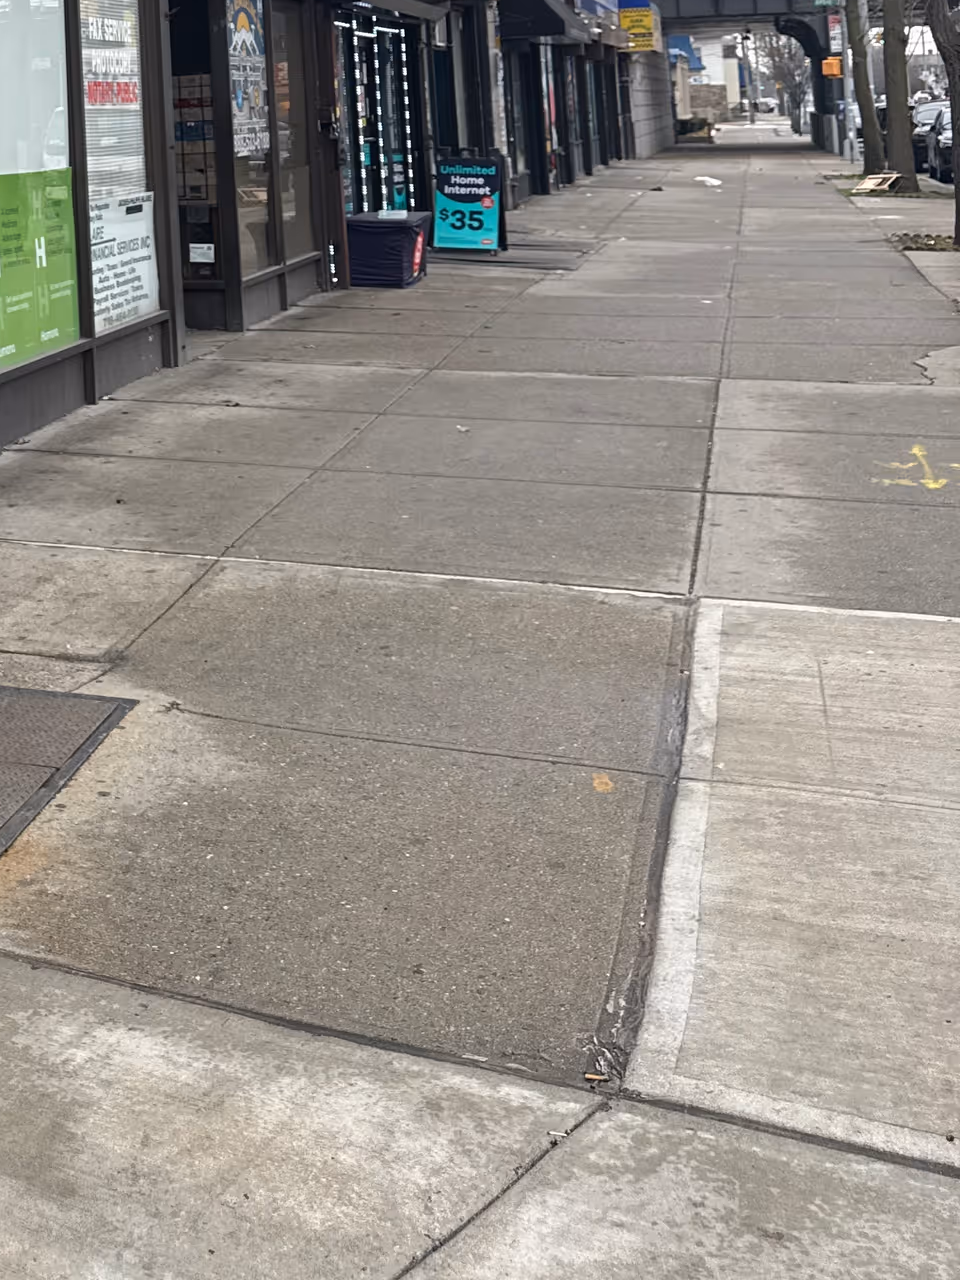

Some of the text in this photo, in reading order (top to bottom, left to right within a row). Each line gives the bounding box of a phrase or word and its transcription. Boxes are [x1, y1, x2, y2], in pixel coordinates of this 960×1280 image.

[88, 17, 103, 40] FAX
[440, 165, 496, 176] Unlimited
[451, 175, 485, 185] Home
[443, 185, 491, 196] Internet
[439, 208, 484, 232] $35
